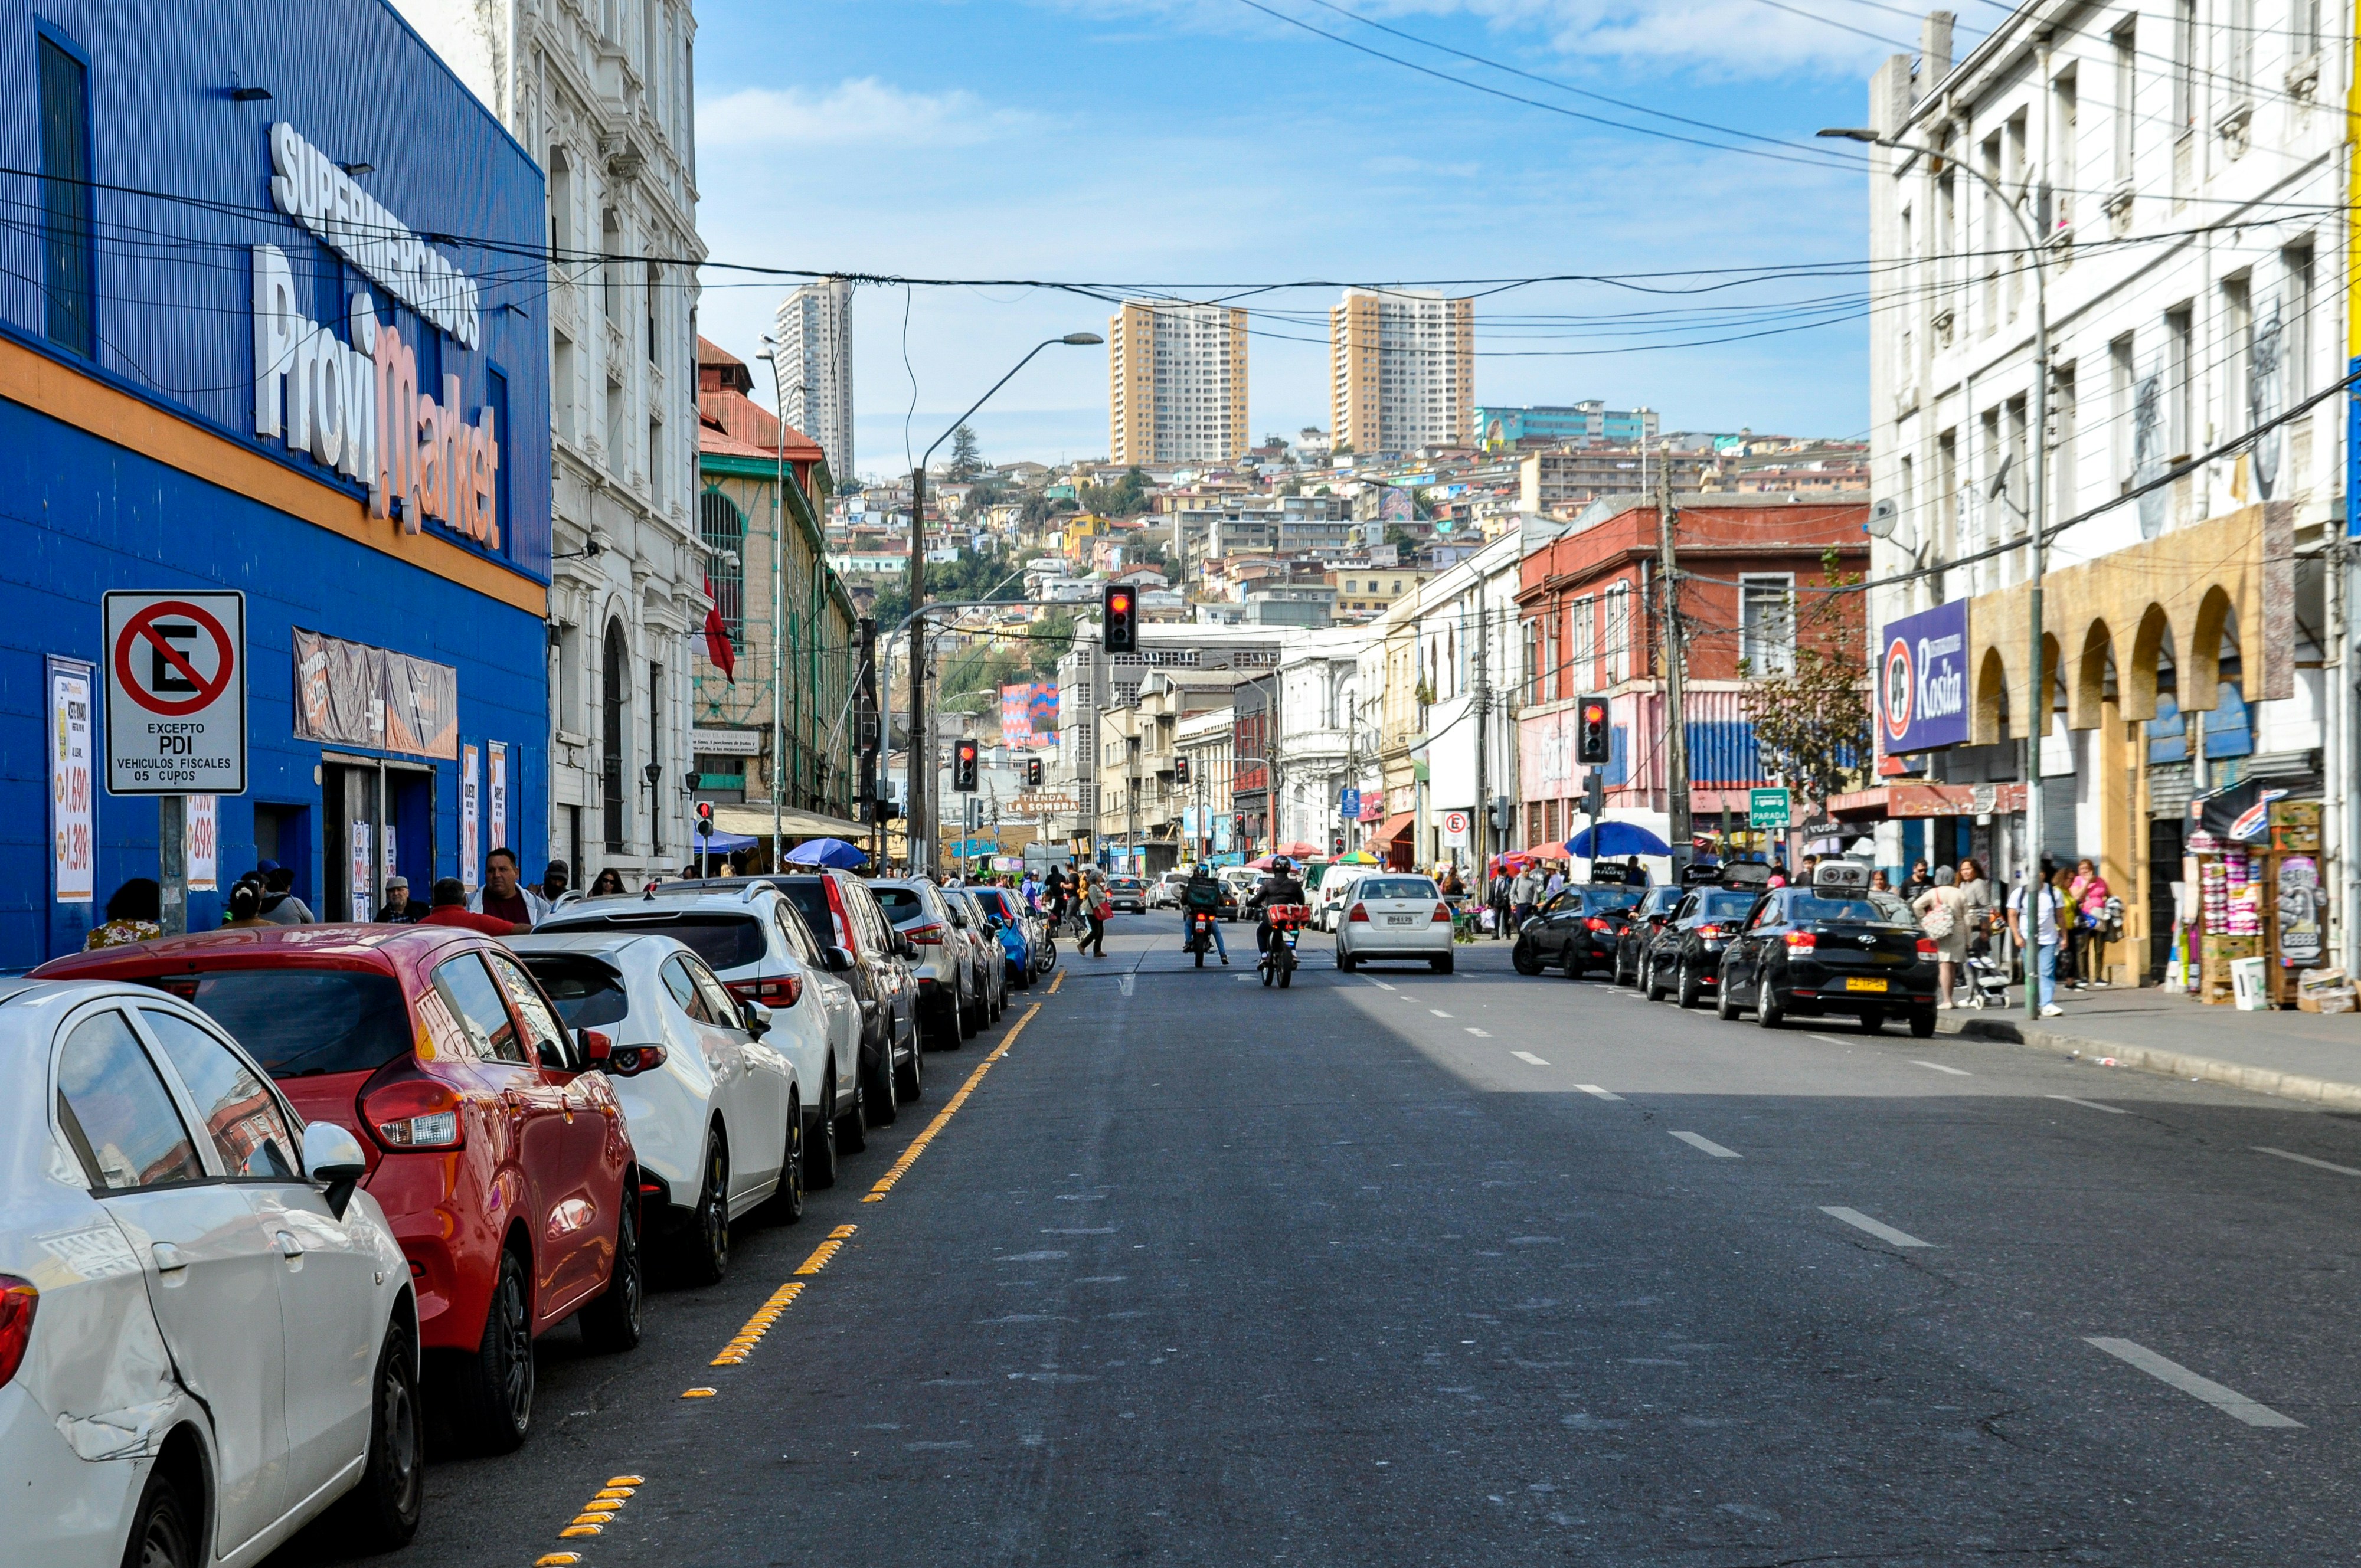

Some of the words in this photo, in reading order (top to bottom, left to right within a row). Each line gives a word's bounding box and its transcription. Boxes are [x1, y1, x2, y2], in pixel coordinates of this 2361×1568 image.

[271, 122, 480, 352] SUPERMERCADOS
[1917, 637, 1963, 721] Rosita
[147, 723, 204, 734] EXCEPTO
[159, 735, 192, 755] PDI
[117, 758, 174, 769] VEHICULOS
[180, 758, 231, 769] FISCALES
[134, 771, 149, 781] 05
[159, 770, 195, 781] CUPOS
[66, 766, 87, 813] 1.690
[1008, 803, 1023, 811] LA
[1028, 803, 1077, 811] SOMBRA
[1753, 811, 1787, 820] PARADA
[67, 823, 87, 870] 1.398
[194, 816, 212, 859] 698
